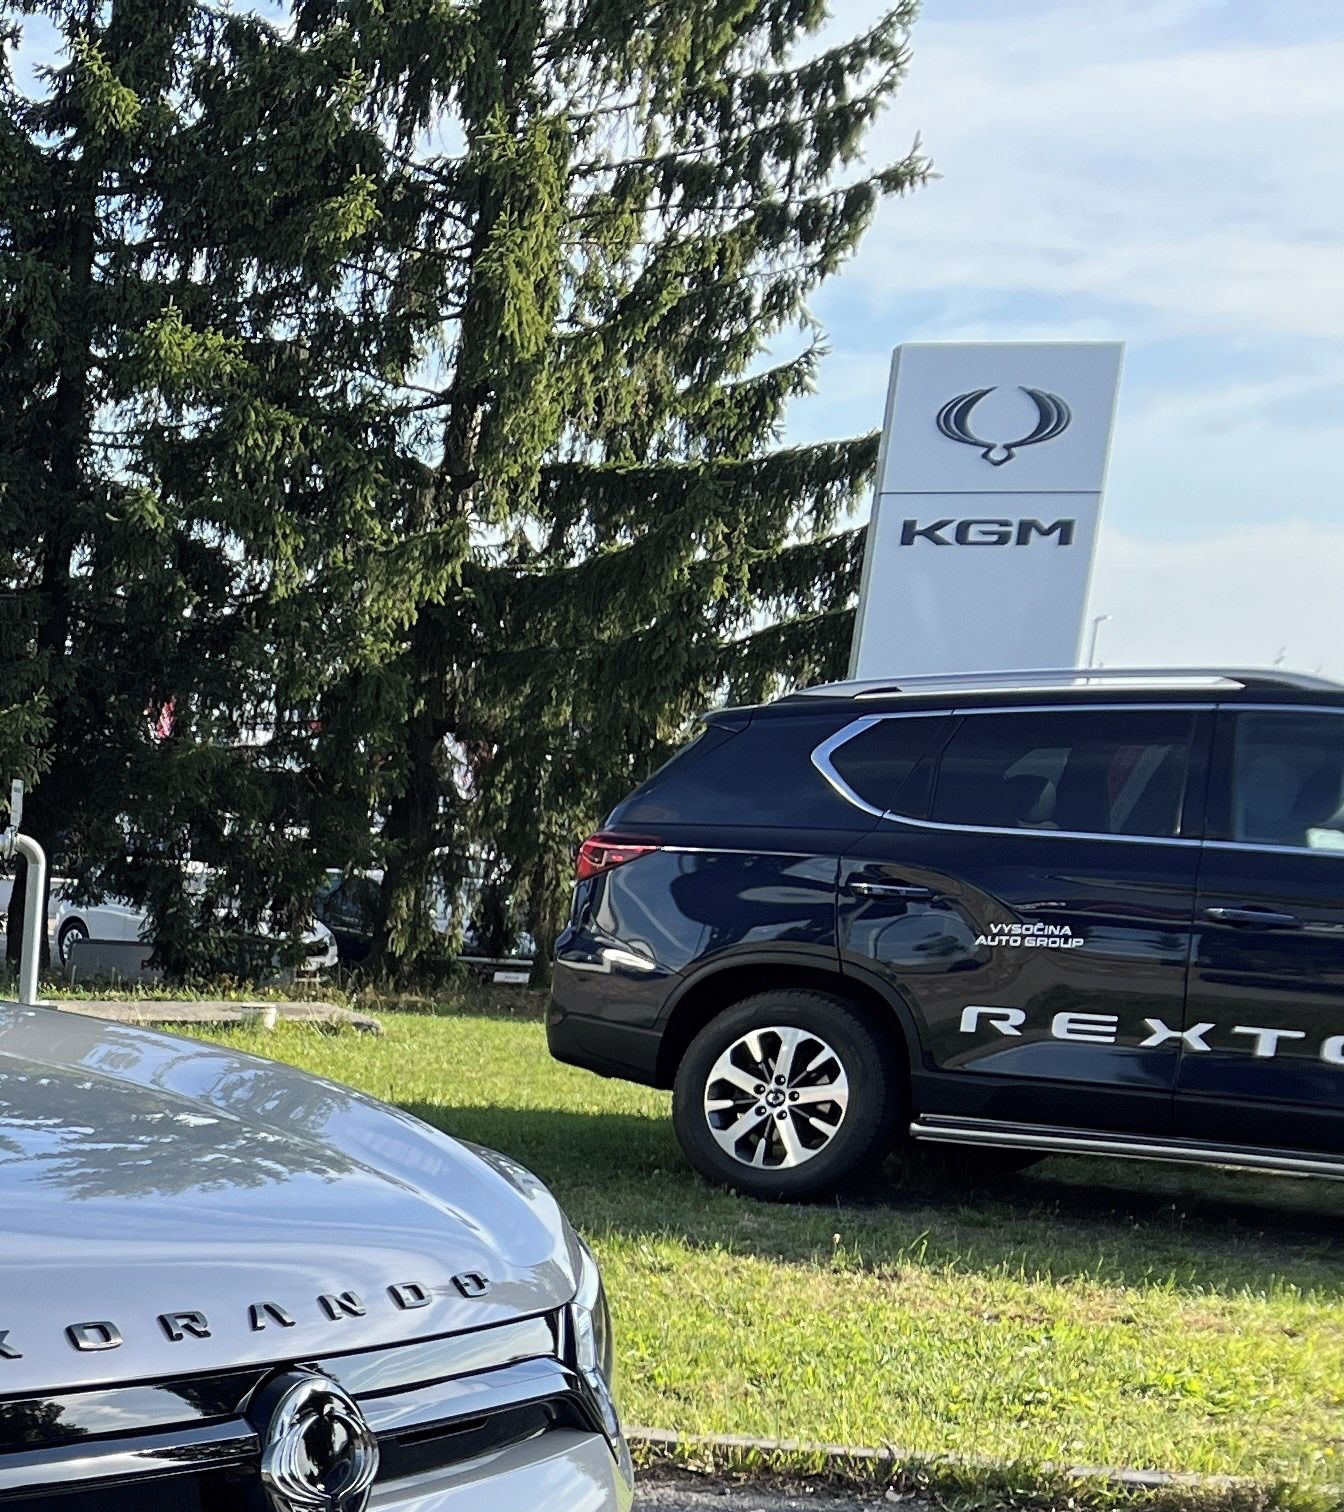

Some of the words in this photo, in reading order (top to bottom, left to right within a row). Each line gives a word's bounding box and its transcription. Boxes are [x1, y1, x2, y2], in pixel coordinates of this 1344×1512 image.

[899, 519, 1077, 547] KGM
[989, 922, 1072, 936] VYSOČINA
[974, 935, 1021, 947] AUTO
[1024, 937, 1084, 949] GROUP
